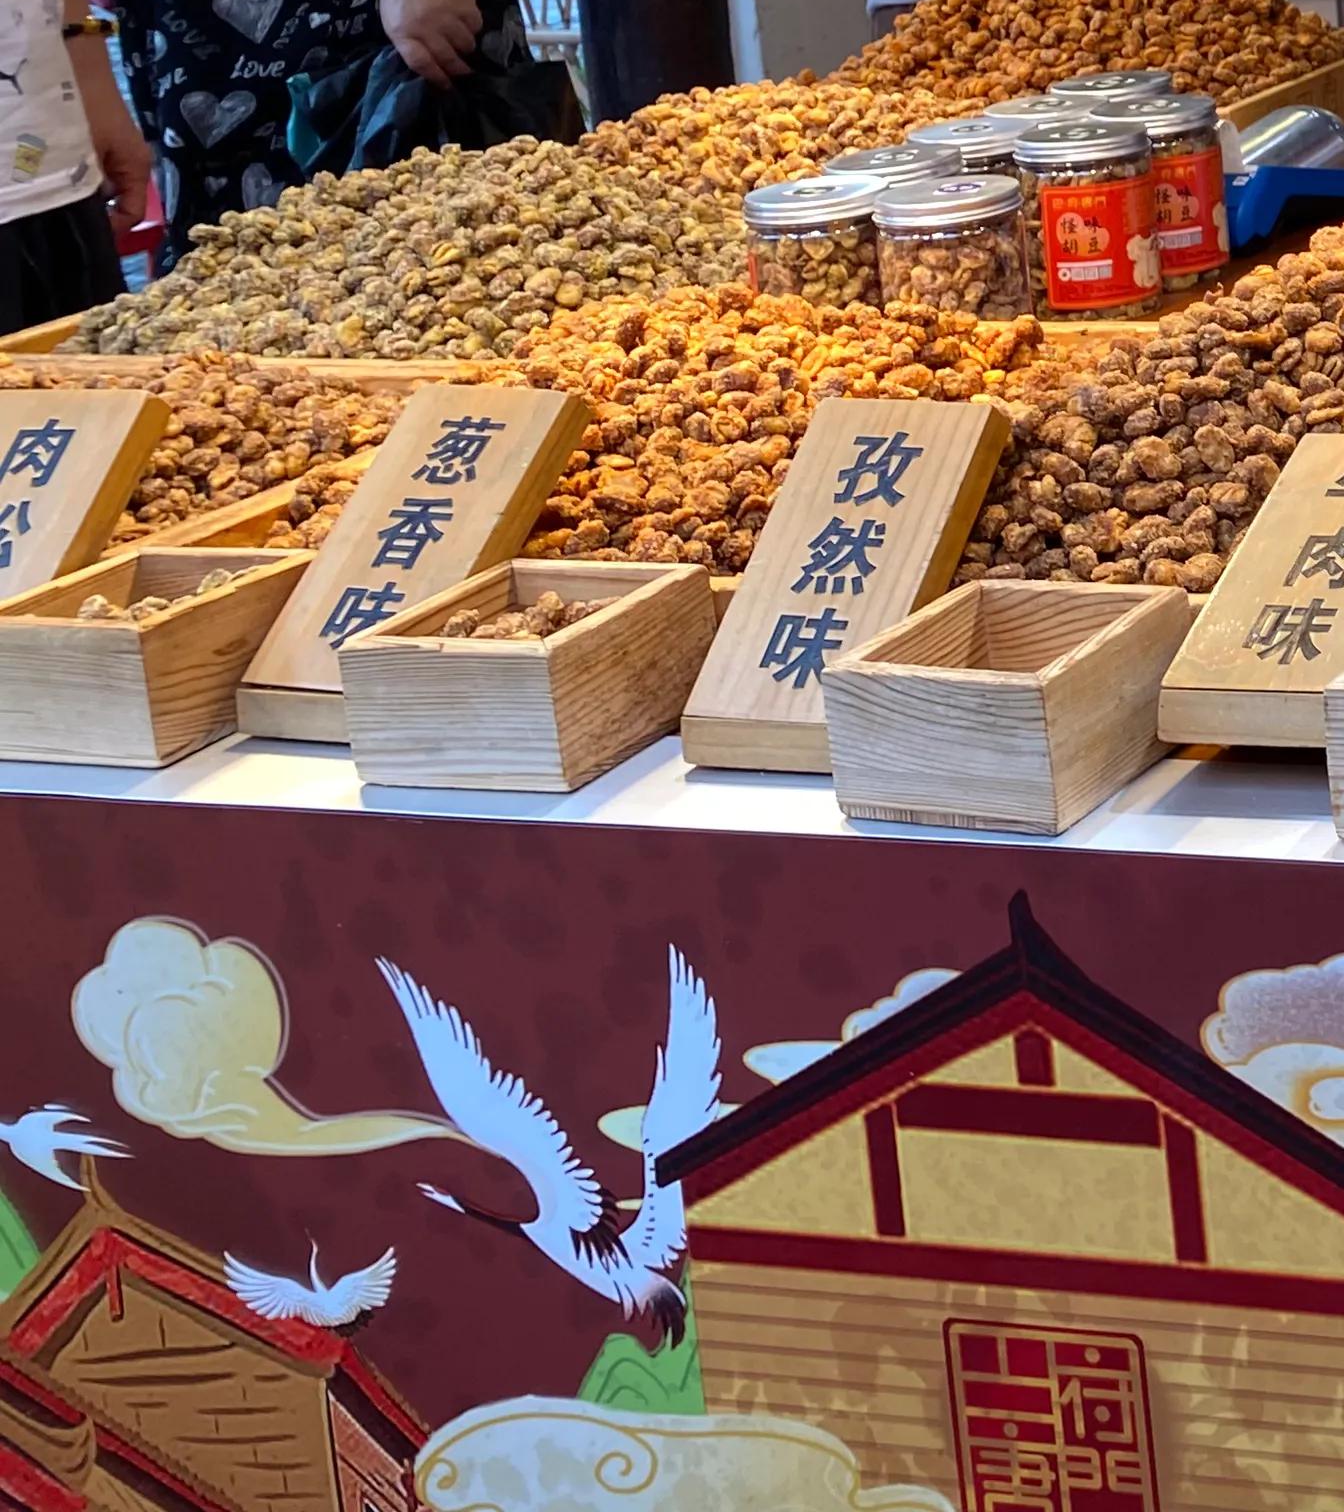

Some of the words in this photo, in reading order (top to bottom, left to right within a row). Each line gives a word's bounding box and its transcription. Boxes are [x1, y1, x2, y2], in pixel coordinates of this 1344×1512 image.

[319, 415, 505, 651] 葱香味
[759, 430, 924, 691] 孜然味
